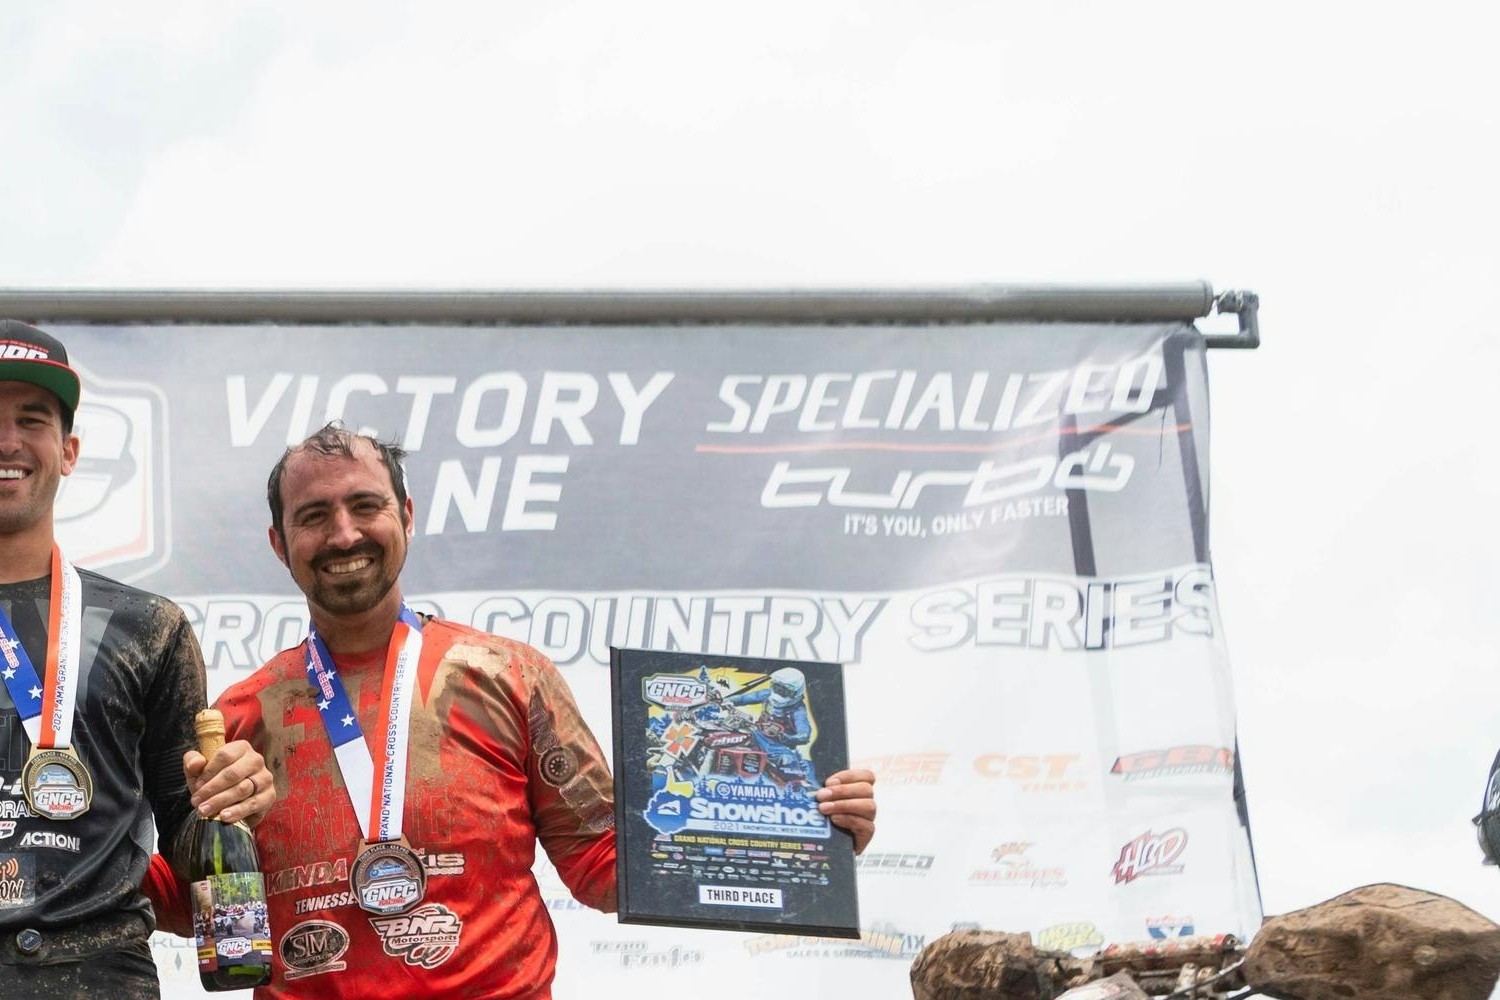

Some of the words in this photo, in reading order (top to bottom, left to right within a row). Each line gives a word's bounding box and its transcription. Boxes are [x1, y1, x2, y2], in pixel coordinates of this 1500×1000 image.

[706, 356, 1165, 434] SPECIALIZED
[225, 370, 675, 450] VICTORY
[760, 442, 1136, 510] turbo
[408, 455, 570, 536] NE
[844, 512, 877, 535] IT'S
[882, 513, 927, 537] YOU,
[931, 509, 984, 535] ONLY
[991, 496, 1070, 524] FASTER
[906, 564, 1214, 653] SERIES
[57, 653, 67, 683] GRAND
[56, 685, 65, 704] AMA
[316, 670, 335, 699] SERIES
[648, 681, 706, 698] GNCC
[388, 684, 401, 722] COUNTRY
[53, 708, 62, 732] 2021
[386, 724, 397, 758] CROSS
[973, 753, 1081, 780] CST
[37, 792, 82, 806] GNCC
[383, 761, 394, 808] NATIONAL
[730, 785, 777, 799] YAMAHA
[689, 797, 826, 827] Snowshoe
[673, 835, 696, 844] GRAND
[697, 836, 727, 846] NATIONAL
[727, 838, 749, 847] CROSS
[749, 839, 779, 849] COUNTRY
[779, 841, 802, 850] SERIES
[266, 858, 348, 897] KENDA
[366, 884, 416, 903] GNCC
[707, 889, 740, 902] THIRD
[742, 891, 775, 904] PLACE
[385, 912, 456, 936] BNR
[391, 933, 458, 946] Motorsports
